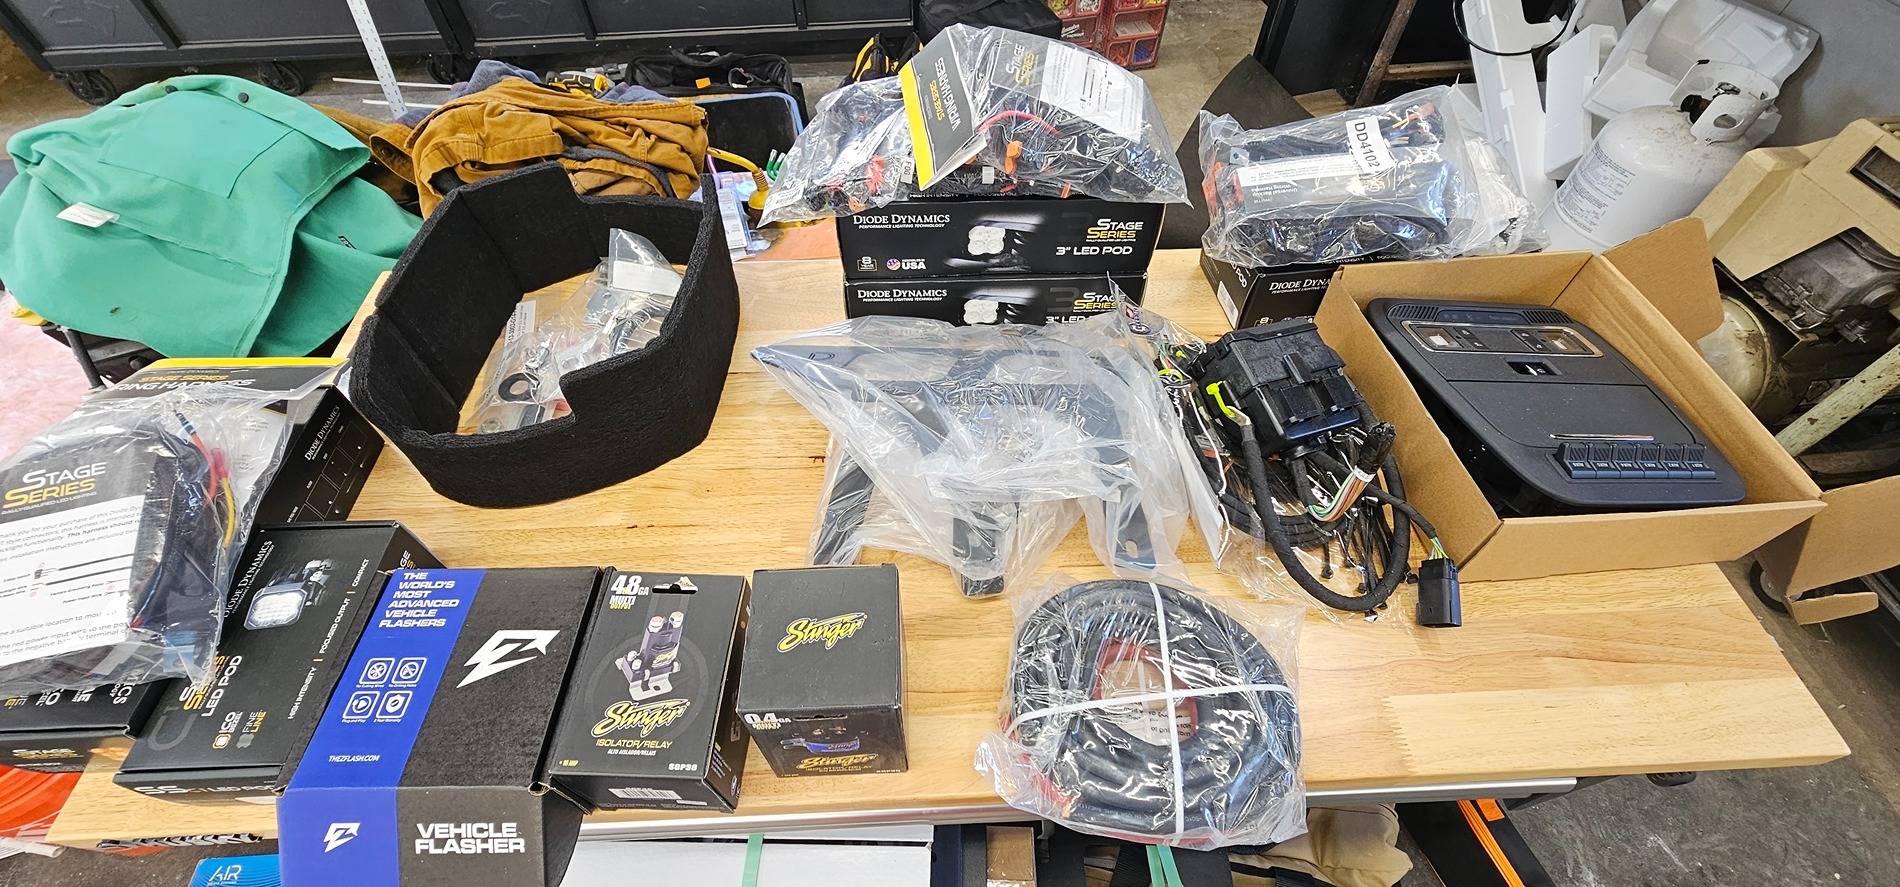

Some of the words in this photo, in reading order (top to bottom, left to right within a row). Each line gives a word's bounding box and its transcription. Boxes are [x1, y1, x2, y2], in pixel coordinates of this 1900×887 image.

[943, 93, 961, 132] WIRING
[1354, 122, 1380, 168] DD4102
[903, 161, 912, 176] FOG
[853, 214, 889, 225] DIODE
[891, 214, 950, 224] DYNAMICS
[1096, 218, 1144, 231] STAGE
[1086, 227, 1136, 239] SERIES
[1055, 246, 1071, 256] 3"
[1073, 246, 1100, 256] LED
[1102, 246, 1133, 255] POD
[861, 256, 872, 264] 8
[901, 262, 927, 270] USA
[1268, 280, 1301, 291] DIODE
[1302, 278, 1331, 288] DYNA
[857, 289, 891, 298] DIODE
[893, 289, 948, 297] DYNAMICS
[116, 382, 162, 391] RING
[304, 437, 321, 461] DIODE
[317, 406, 340, 440] DYNAMICS
[22, 462, 108, 491] STAGE
[2, 479, 97, 509] SERIES
[67, 530, 81, 538] This
[82, 525, 108, 534] harness
[109, 519, 133, 528] should
[238, 540, 273, 591] DYNAMICS
[403, 572, 429, 580] THE
[399, 580, 456, 589] WORLD'S
[638, 587, 650, 596] GA
[392, 590, 432, 599] MOST
[387, 599, 460, 608] ADVANCED
[384, 609, 438, 618] VEHICLE
[379, 618, 447, 628] FLASHERS
[288, 701, 301, 720] HIGH
[298, 667, 317, 703] INTENSITY
[319, 623, 339, 654] FOCUSED
[334, 597, 351, 625] OUTPUT
[352, 558, 370, 588] COMPACT
[777, 612, 868, 653] Stinger
[201, 689, 224, 717] LED
[217, 655, 243, 687] POD
[219, 711, 236, 733] ICO
[242, 711, 258, 733] FINE
[250, 711, 267, 733] LINE
[591, 698, 691, 738] Stinger
[595, 738, 673, 749] ISOLATOR/RELAY
[327, 754, 381, 763] THEZFLASH.COM
[796, 753, 879, 770] Stinger
[415, 822, 518, 839] VEHICLE
[414, 838, 525, 855] FLASHER
[208, 864, 242, 882] AIR
